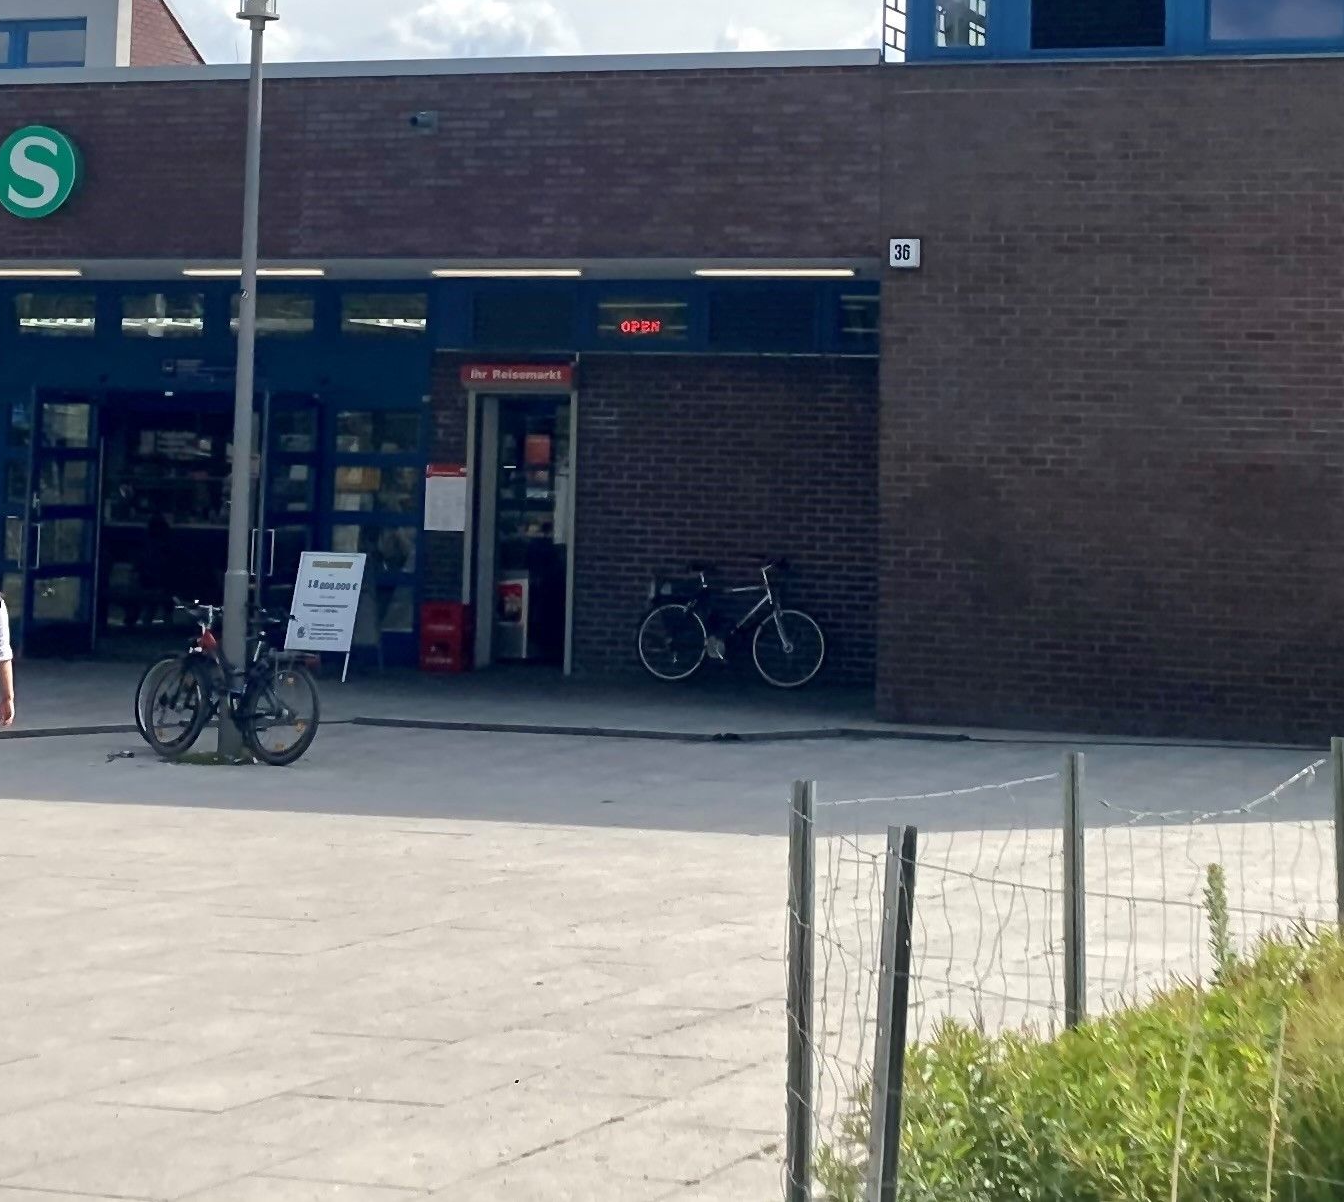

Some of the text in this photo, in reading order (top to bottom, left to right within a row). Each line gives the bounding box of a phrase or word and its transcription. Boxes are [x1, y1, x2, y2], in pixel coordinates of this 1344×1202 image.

[8, 135, 60, 209] S
[894, 243, 911, 261] 36
[619, 319, 662, 335] OPEN
[492, 369, 562, 381] Reisemarkt
